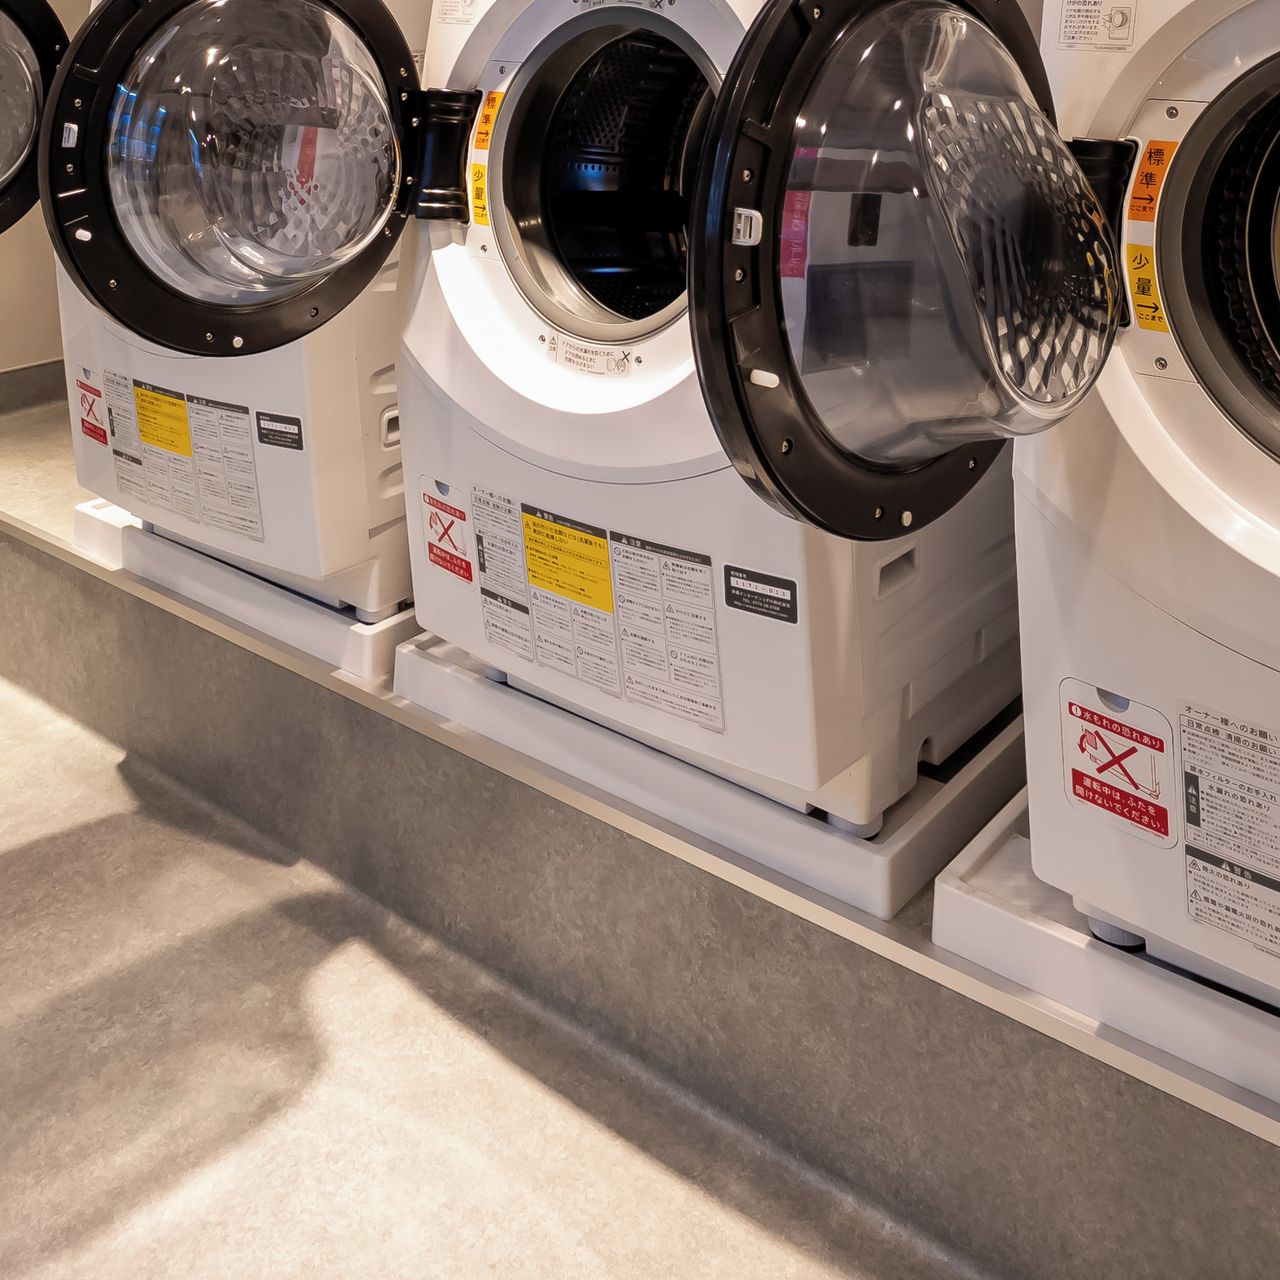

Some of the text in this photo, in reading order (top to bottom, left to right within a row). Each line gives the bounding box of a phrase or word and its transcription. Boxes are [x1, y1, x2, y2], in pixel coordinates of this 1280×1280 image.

[1139, 148, 1165, 188] 標準
[1132, 253, 1152, 296] 少量
[1138, 313, 1163, 322] ここまで
[1083, 711, 1160, 748] 水もれの恐れあり
[1185, 705, 1278, 742] オーナー様へのお願い
[1082, 777, 1156, 816] 運転中は、ふたを
[1190, 765, 1277, 802] 排水フィルターのお手入れ
[1208, 784, 1270, 811] 水漏れの恐れあり
[1075, 785, 1165, 832] 開けないでください。
